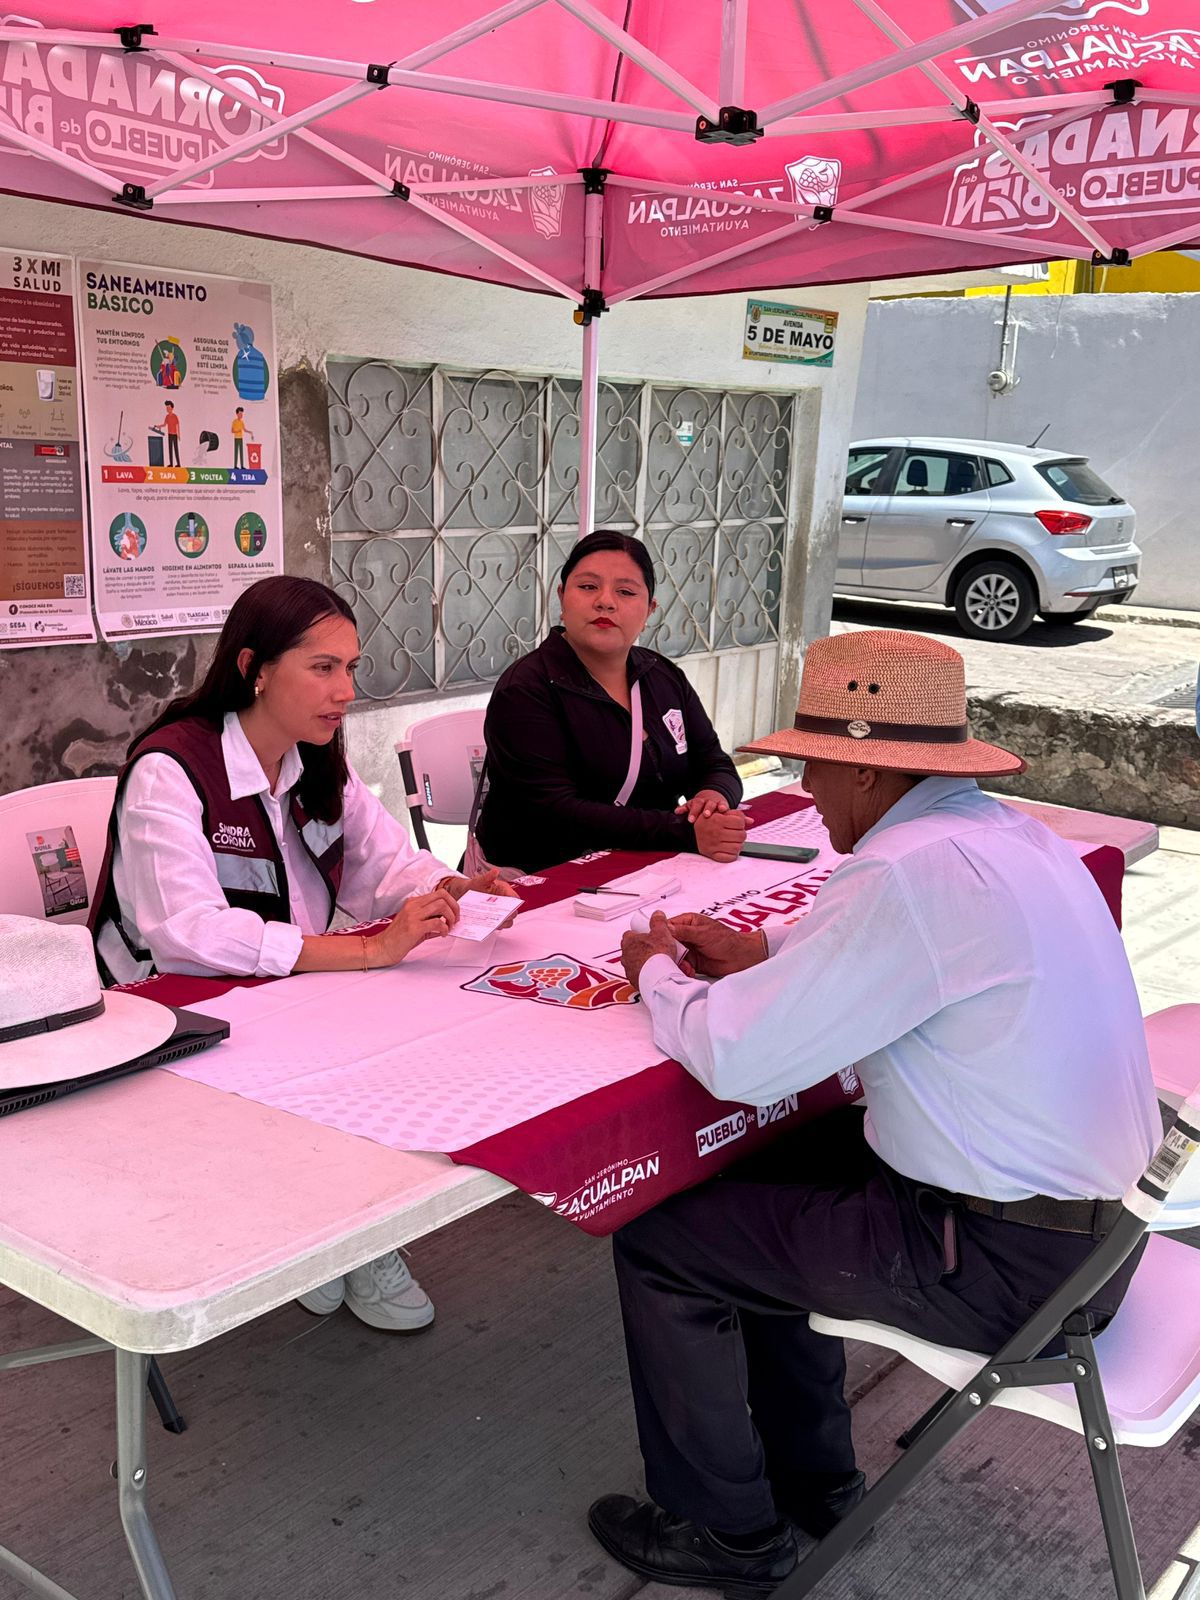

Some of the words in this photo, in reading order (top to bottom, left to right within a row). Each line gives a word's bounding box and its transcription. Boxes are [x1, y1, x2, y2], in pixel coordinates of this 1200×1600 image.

[13, 256, 22, 272] 3
[27, 258, 38, 274] X
[41, 260, 61, 277] MI
[13, 276, 61, 292] SALUD
[86, 272, 207, 302] SANEAMIENTO
[87, 289, 154, 315] BÁSICO
[783, 319, 804, 329] AVENIDA
[96, 329, 120, 337] MANTÉN
[121, 331, 145, 339] LIMPIOS
[747, 325, 758, 341] 5
[762, 327, 785, 345] DE
[789, 330, 834, 350] MAYO
[109, 338, 140, 347] ENTORNOS
[193, 337, 217, 345] ASEGURA
[103, 469, 109, 479] 1
[115, 471, 134, 480] LAVA
[147, 470, 154, 480] 2
[159, 471, 176, 480] TAPA
[190, 471, 196, 481] 3
[200, 472, 224, 481] VOLTEA
[230, 472, 237, 482] 4
[241, 473, 256, 482] TIRA
[10, 621, 26, 629] SESA
[134, 618, 158, 627] México
[698, 1114, 745, 1152] PUEBLO
[747, 1113, 756, 1123] de
[584, 1175, 596, 1187] SAN
[596, 1158, 629, 1179] JERÓNIMO
